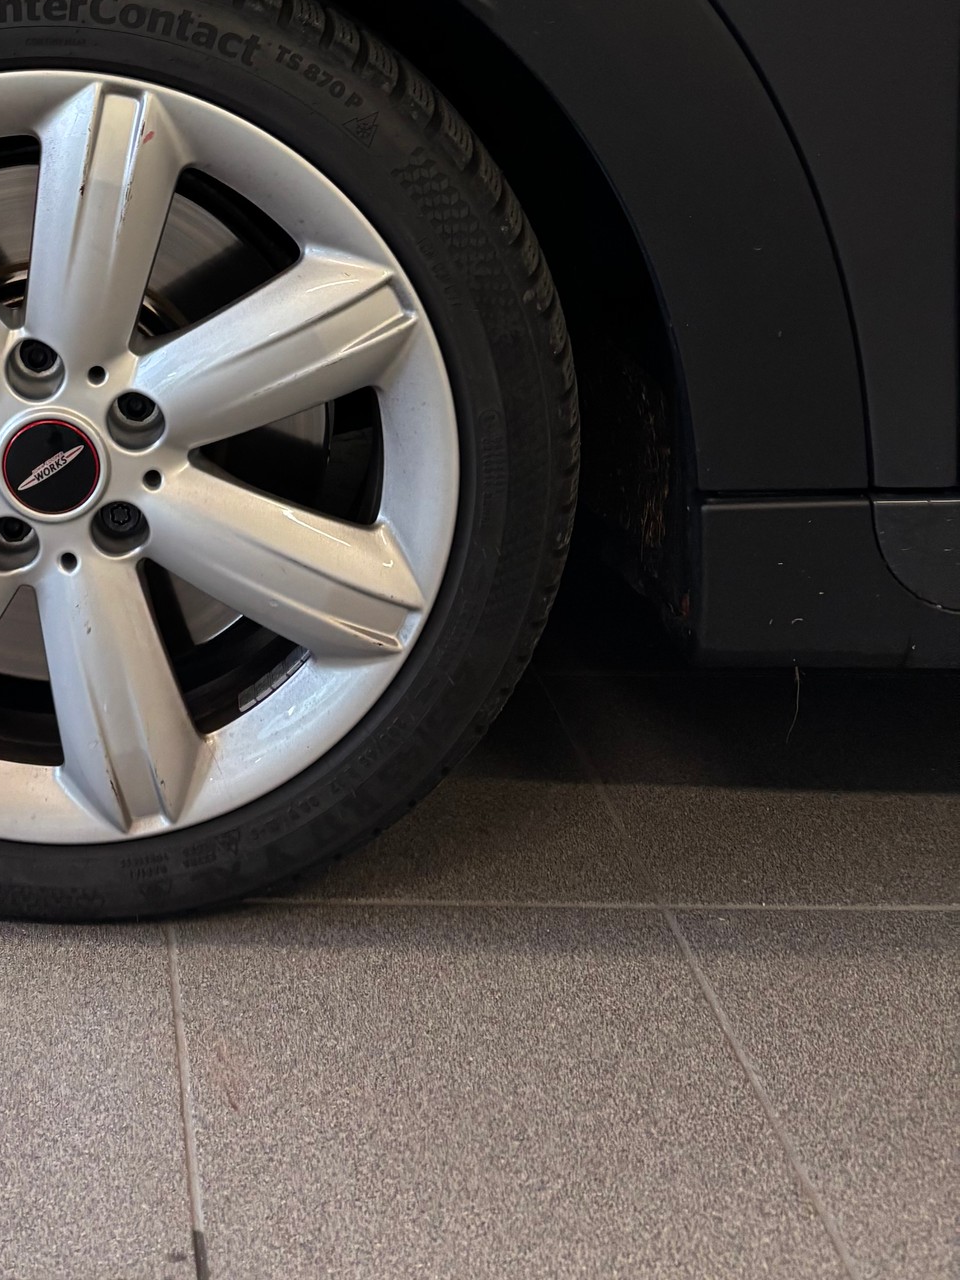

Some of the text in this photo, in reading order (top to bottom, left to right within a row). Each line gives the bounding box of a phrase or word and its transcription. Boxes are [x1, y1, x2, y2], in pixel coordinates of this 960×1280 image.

[276, 44, 301, 71] TS
[303, 66, 345, 99] 870
[344, 91, 364, 109] P
[33, 455, 68, 481] WORKS
